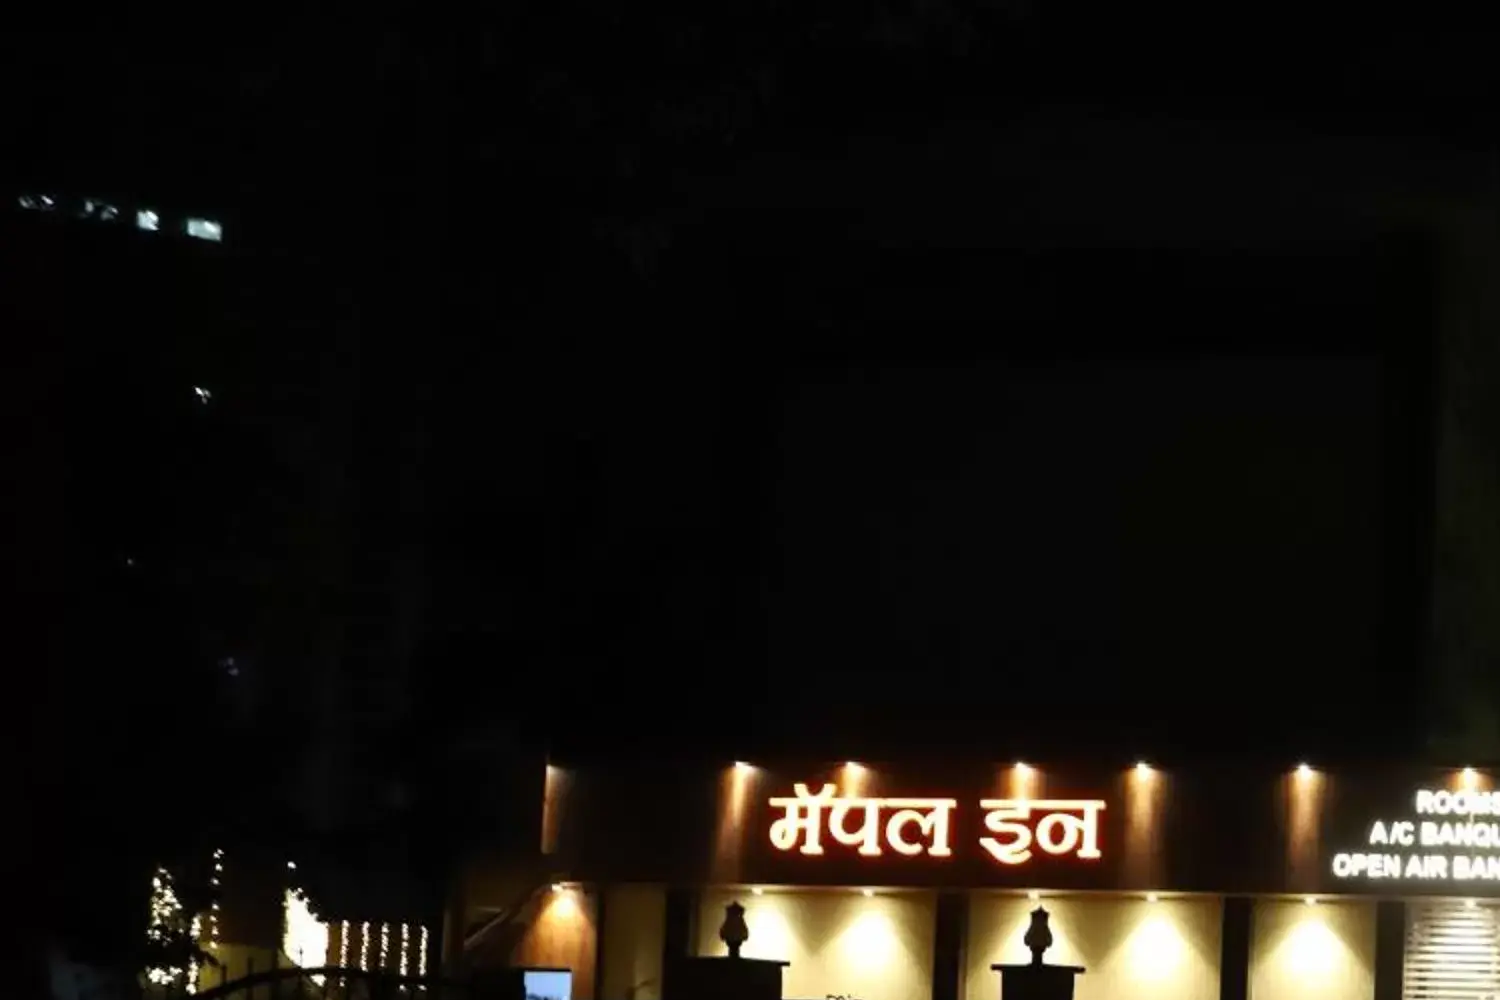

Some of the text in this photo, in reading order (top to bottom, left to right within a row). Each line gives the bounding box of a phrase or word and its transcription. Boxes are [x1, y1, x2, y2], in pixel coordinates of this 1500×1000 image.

[979, 799, 1106, 864] इन
[1369, 821, 1415, 846] A/C
[1332, 853, 1400, 878] OPEN
[1404, 854, 1447, 879] AIR
